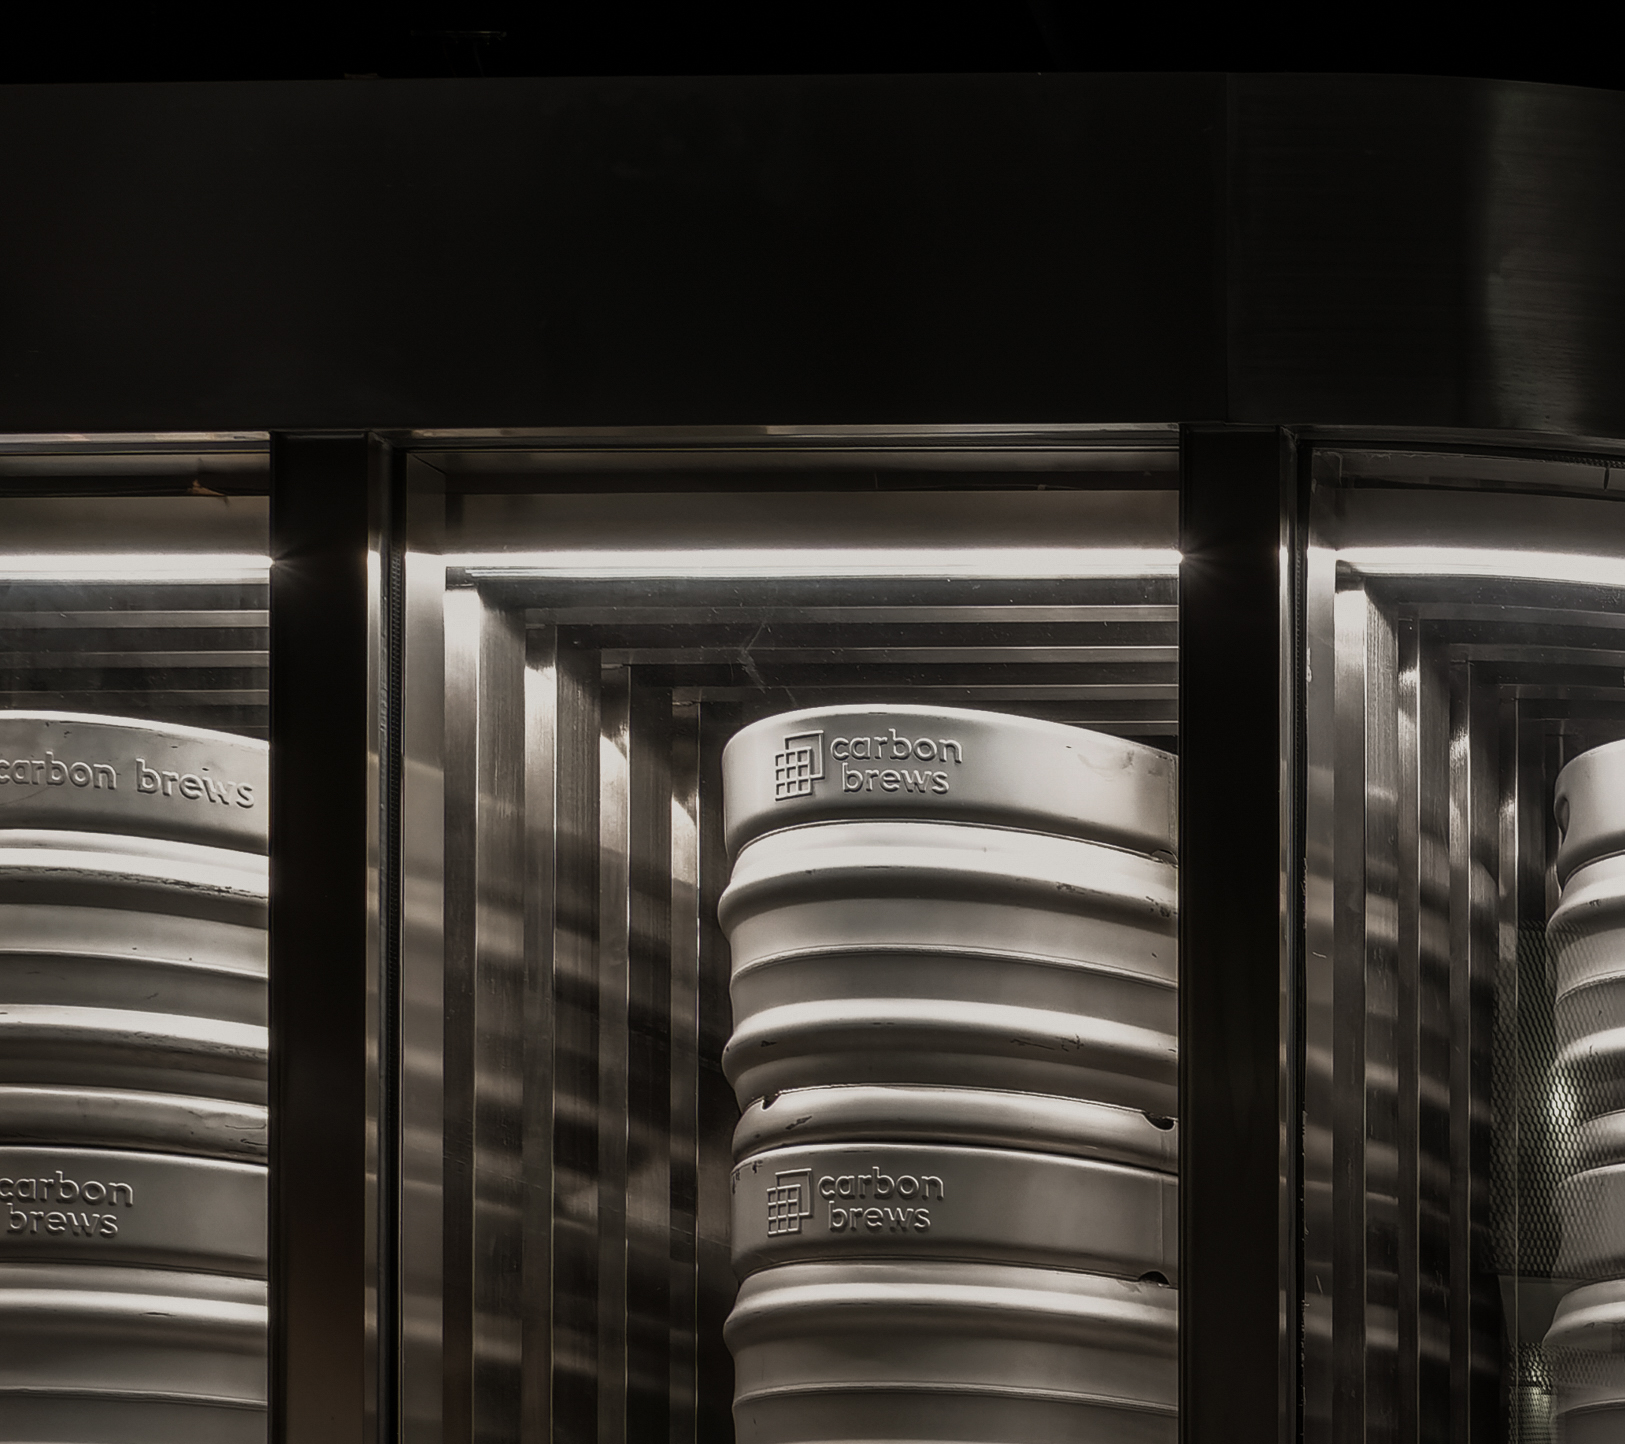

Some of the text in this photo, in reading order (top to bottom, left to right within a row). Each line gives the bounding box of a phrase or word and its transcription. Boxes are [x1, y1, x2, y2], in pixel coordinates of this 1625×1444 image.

[830, 728, 963, 764] carbon
[0, 751, 255, 809] carbon brews
[842, 762, 950, 794] brews
[0, 1170, 134, 1207] carbon
[818, 1166, 945, 1201] carbon
[6, 1203, 119, 1238] brews
[828, 1200, 932, 1234] brews
